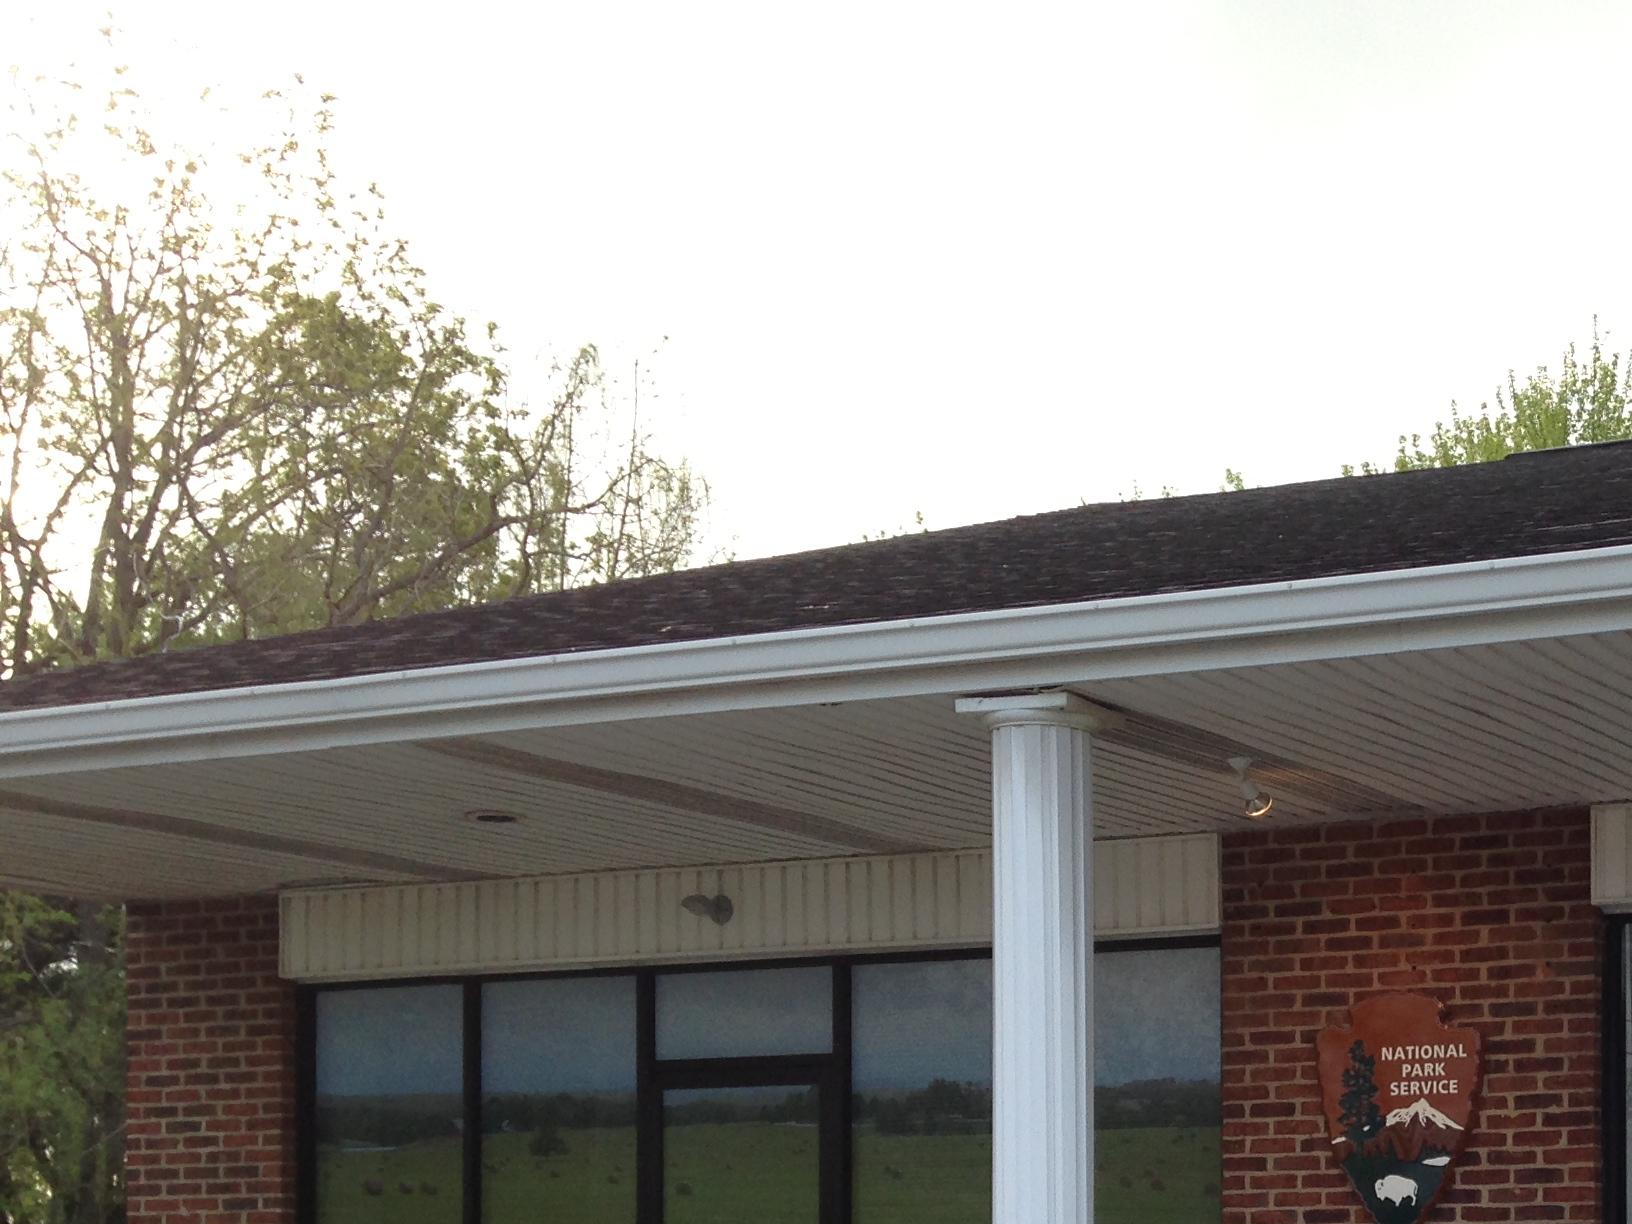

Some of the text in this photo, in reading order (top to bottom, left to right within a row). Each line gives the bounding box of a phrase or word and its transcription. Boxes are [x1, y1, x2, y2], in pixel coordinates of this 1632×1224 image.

[1381, 1044, 1467, 1061] NATIONAL
[1402, 1062, 1446, 1078] PARK
[1390, 1079, 1459, 1096] SERVICE
